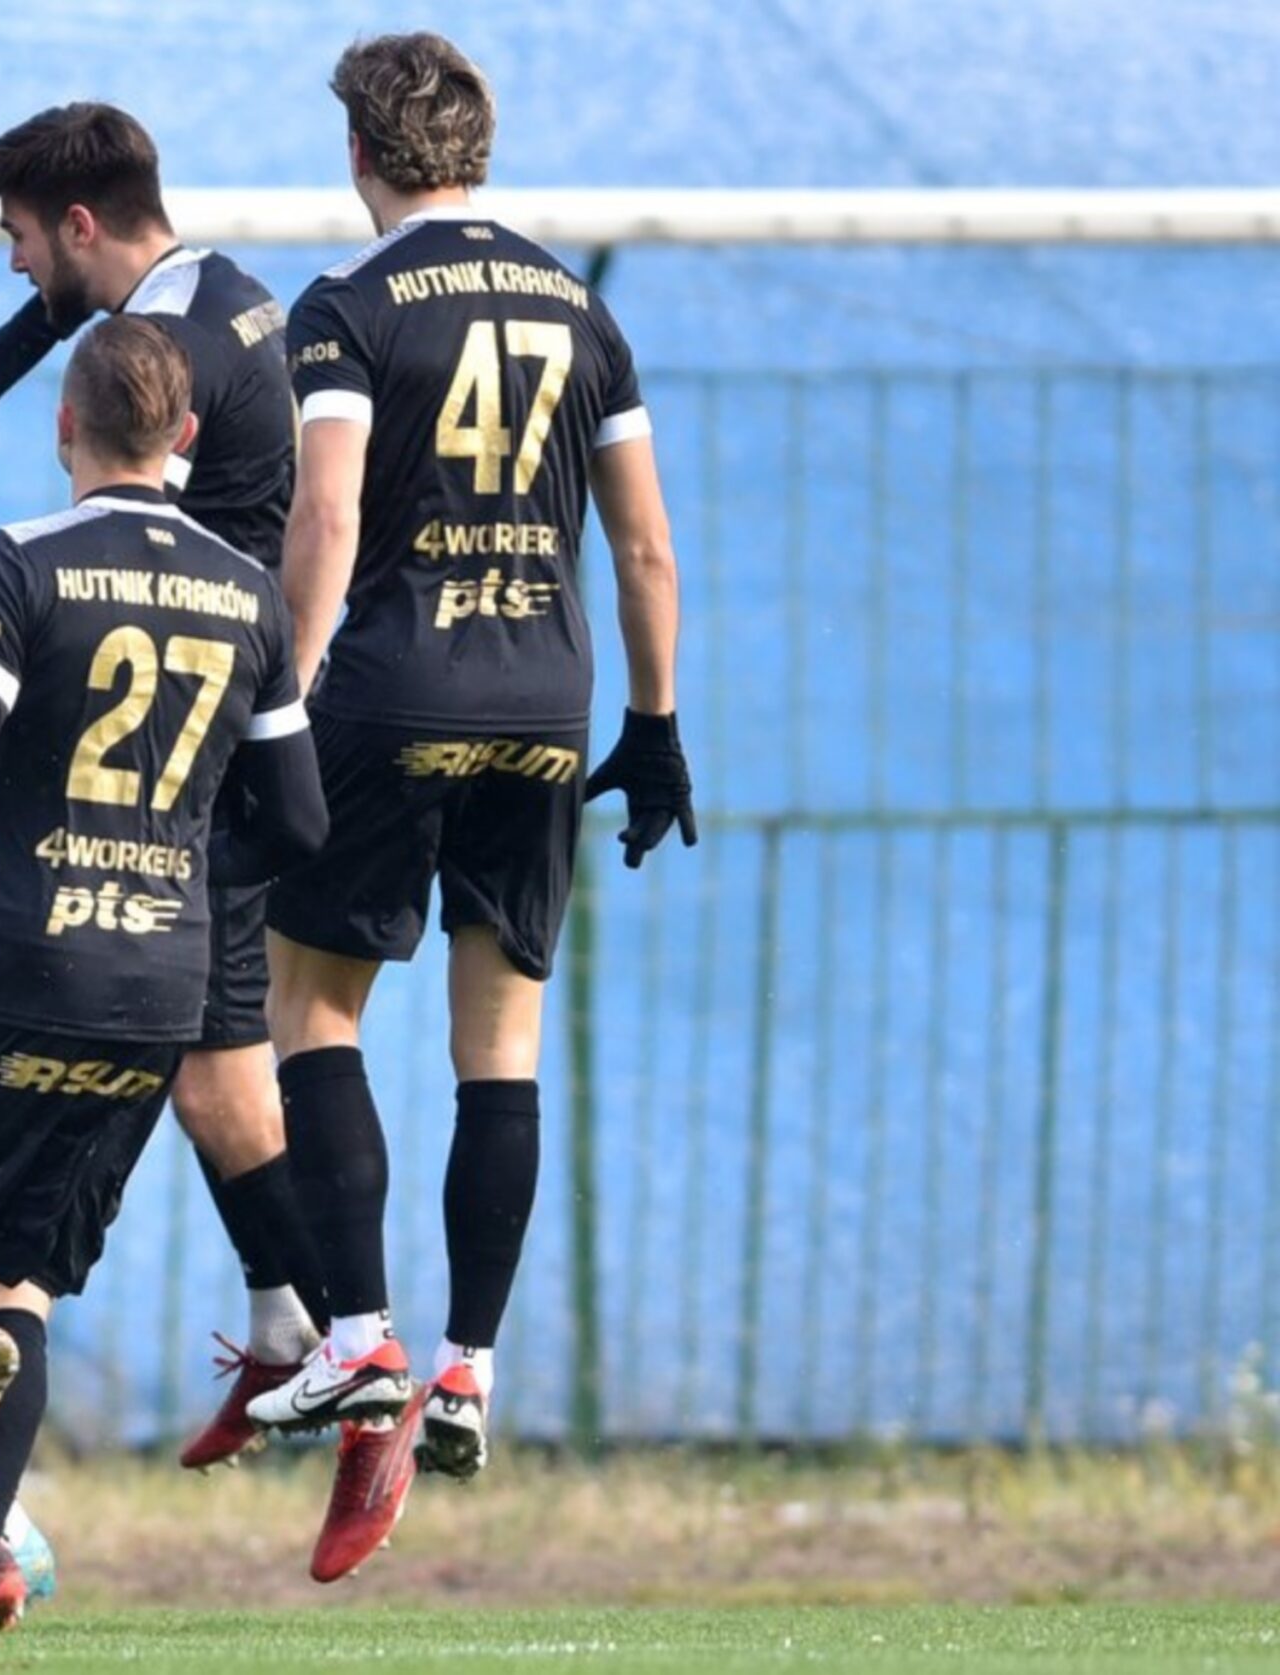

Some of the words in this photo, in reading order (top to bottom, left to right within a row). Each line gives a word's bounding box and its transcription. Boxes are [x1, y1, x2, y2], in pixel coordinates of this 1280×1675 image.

[386, 261, 488, 305] HUTNIK
[489, 261, 589, 311] KRAKÓW
[435, 320, 573, 495] 47
[56, 568, 155, 606] HUTNIK
[157, 573, 259, 625] KRAKÓW
[66, 626, 236, 812] 27
[45, 881, 183, 935] pts
